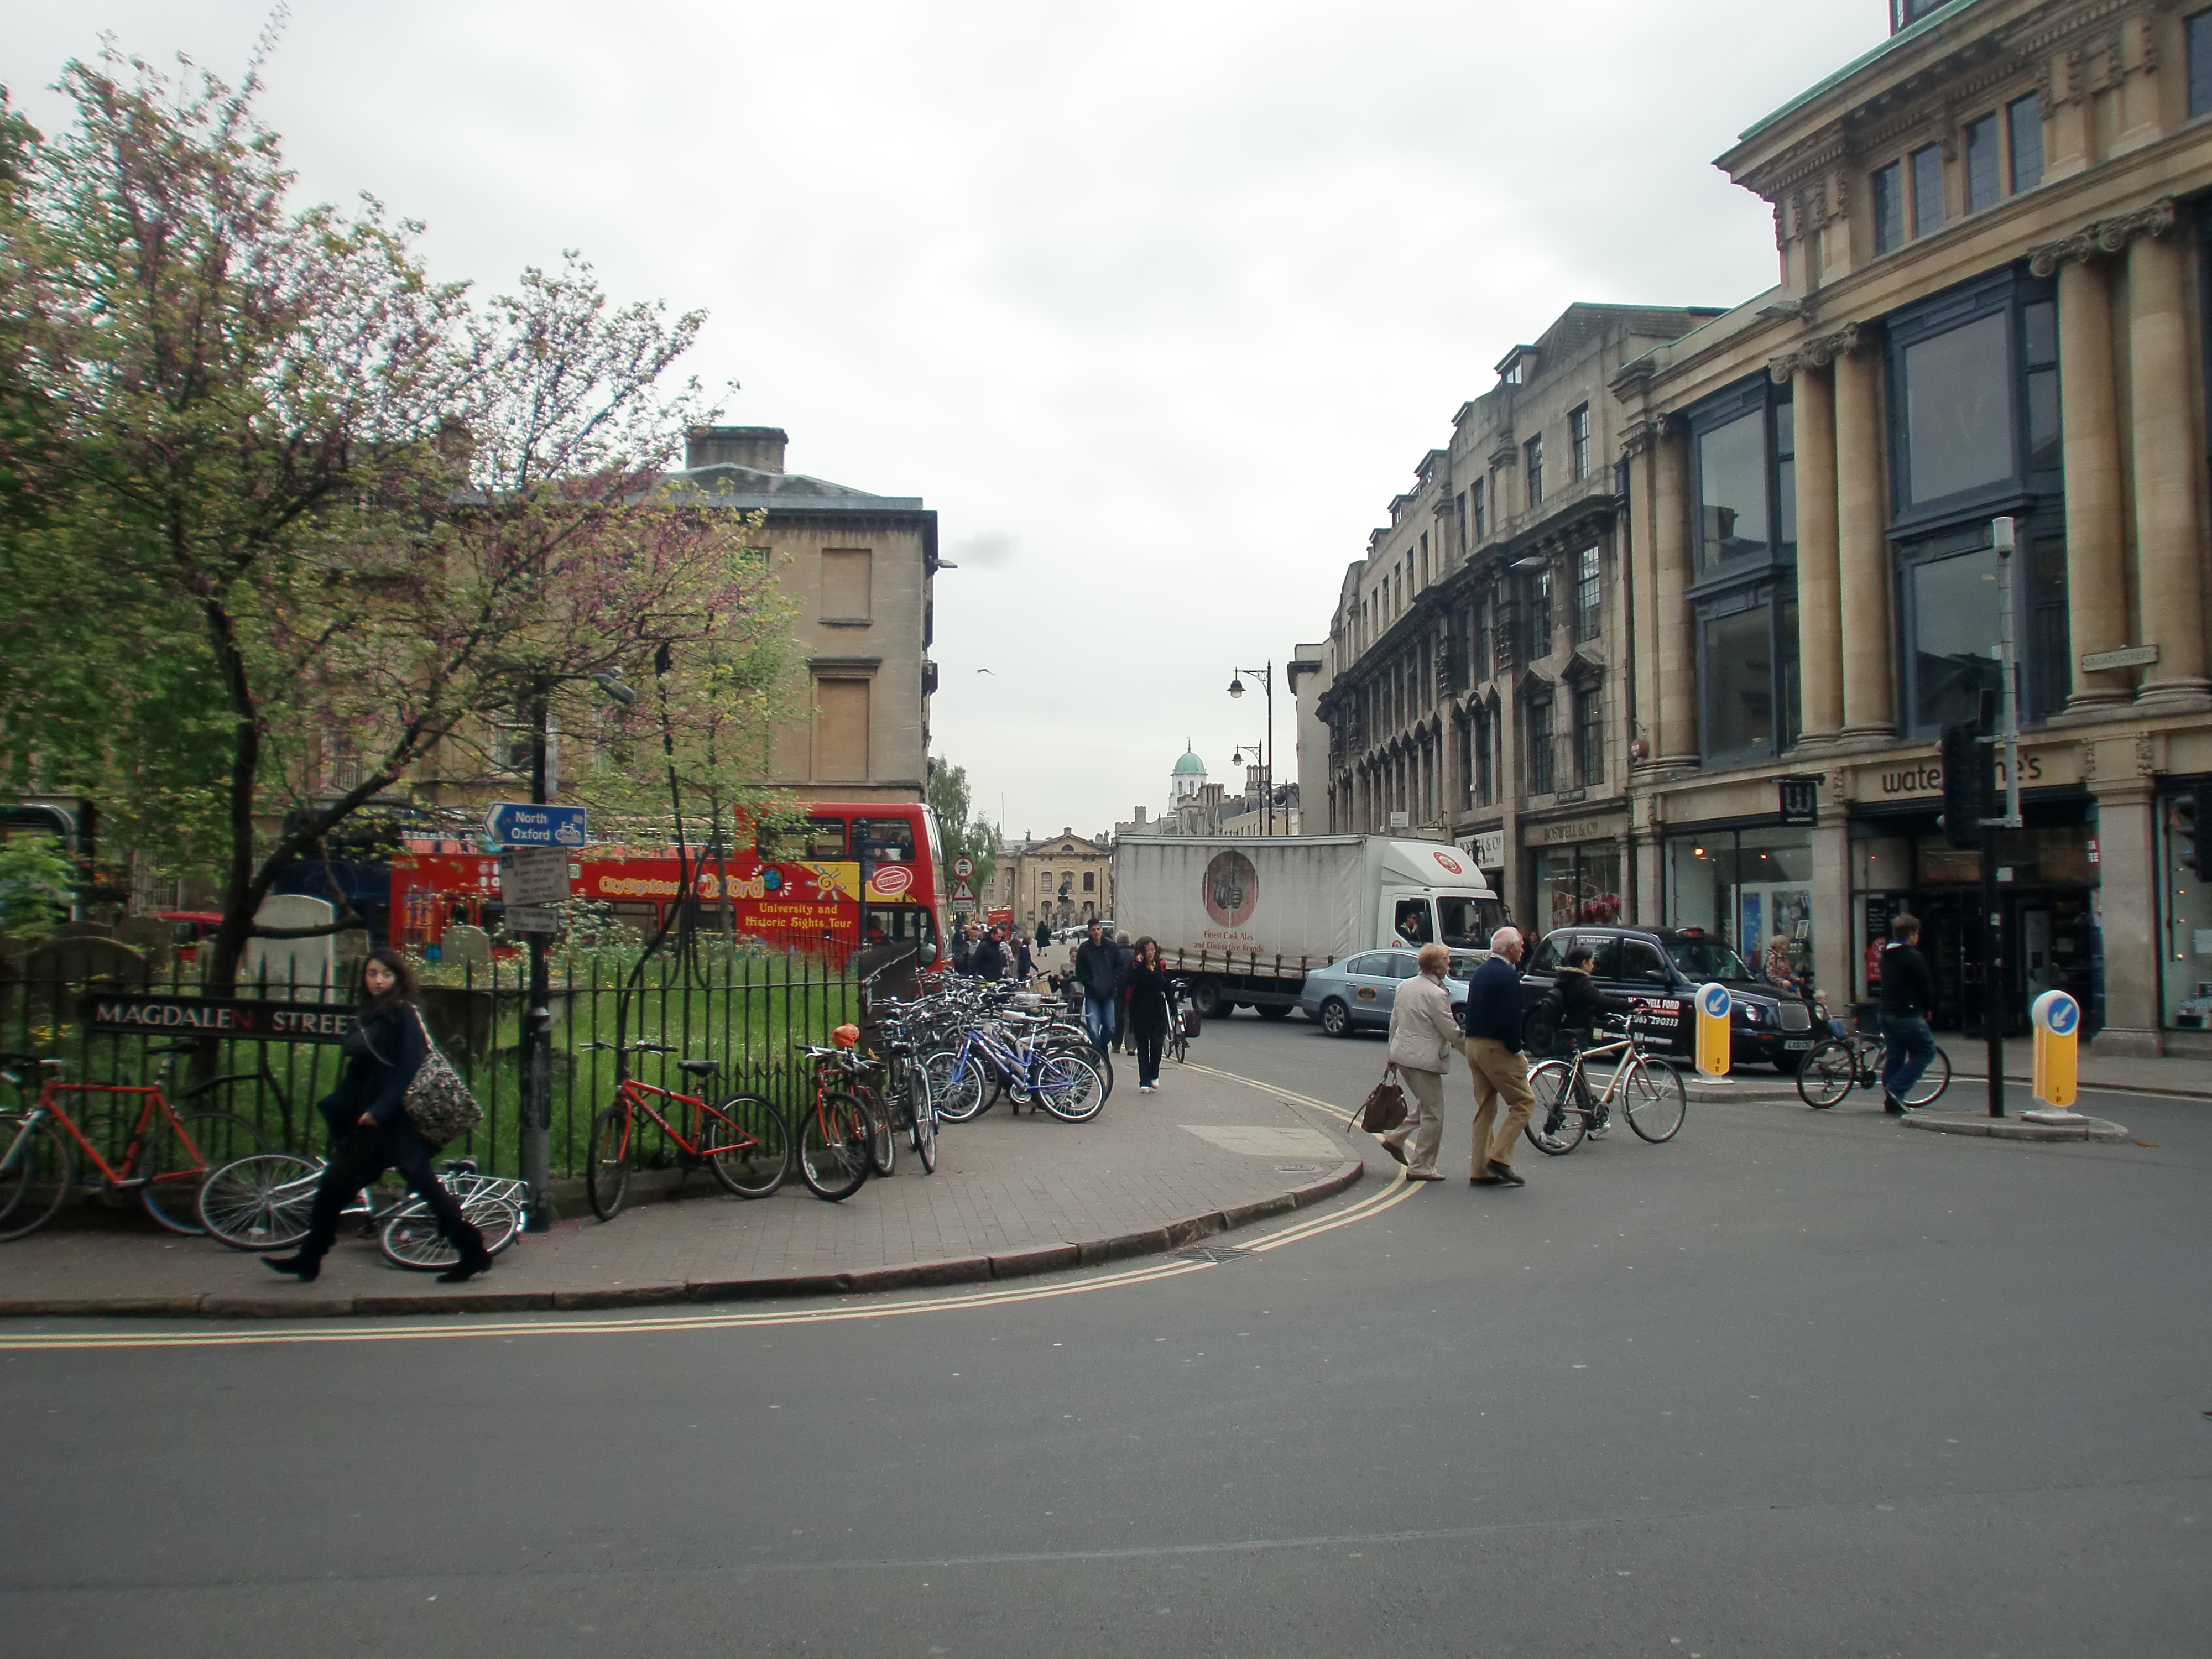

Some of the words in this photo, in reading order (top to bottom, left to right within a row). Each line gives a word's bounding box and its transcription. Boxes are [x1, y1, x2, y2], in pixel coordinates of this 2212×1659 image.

[515, 811, 547, 824] North
[511, 827, 551, 841] Oxford
[759, 902, 813, 915] University
[818, 904, 838, 914] and
[745, 916, 786, 927] Historic
[791, 917, 825, 930] Sights
[829, 918, 852, 928] Tour
[1204, 930, 1222, 939] Finest
[1223, 931, 1238, 940] Cask
[1240, 932, 1254, 941] Ales
[1207, 942, 1240, 951] Distinctive
[1242, 944, 1264, 952] Brands
[1662, 1000, 1679, 1009] FORD
[95, 1002, 254, 1030] MAGDALEN
